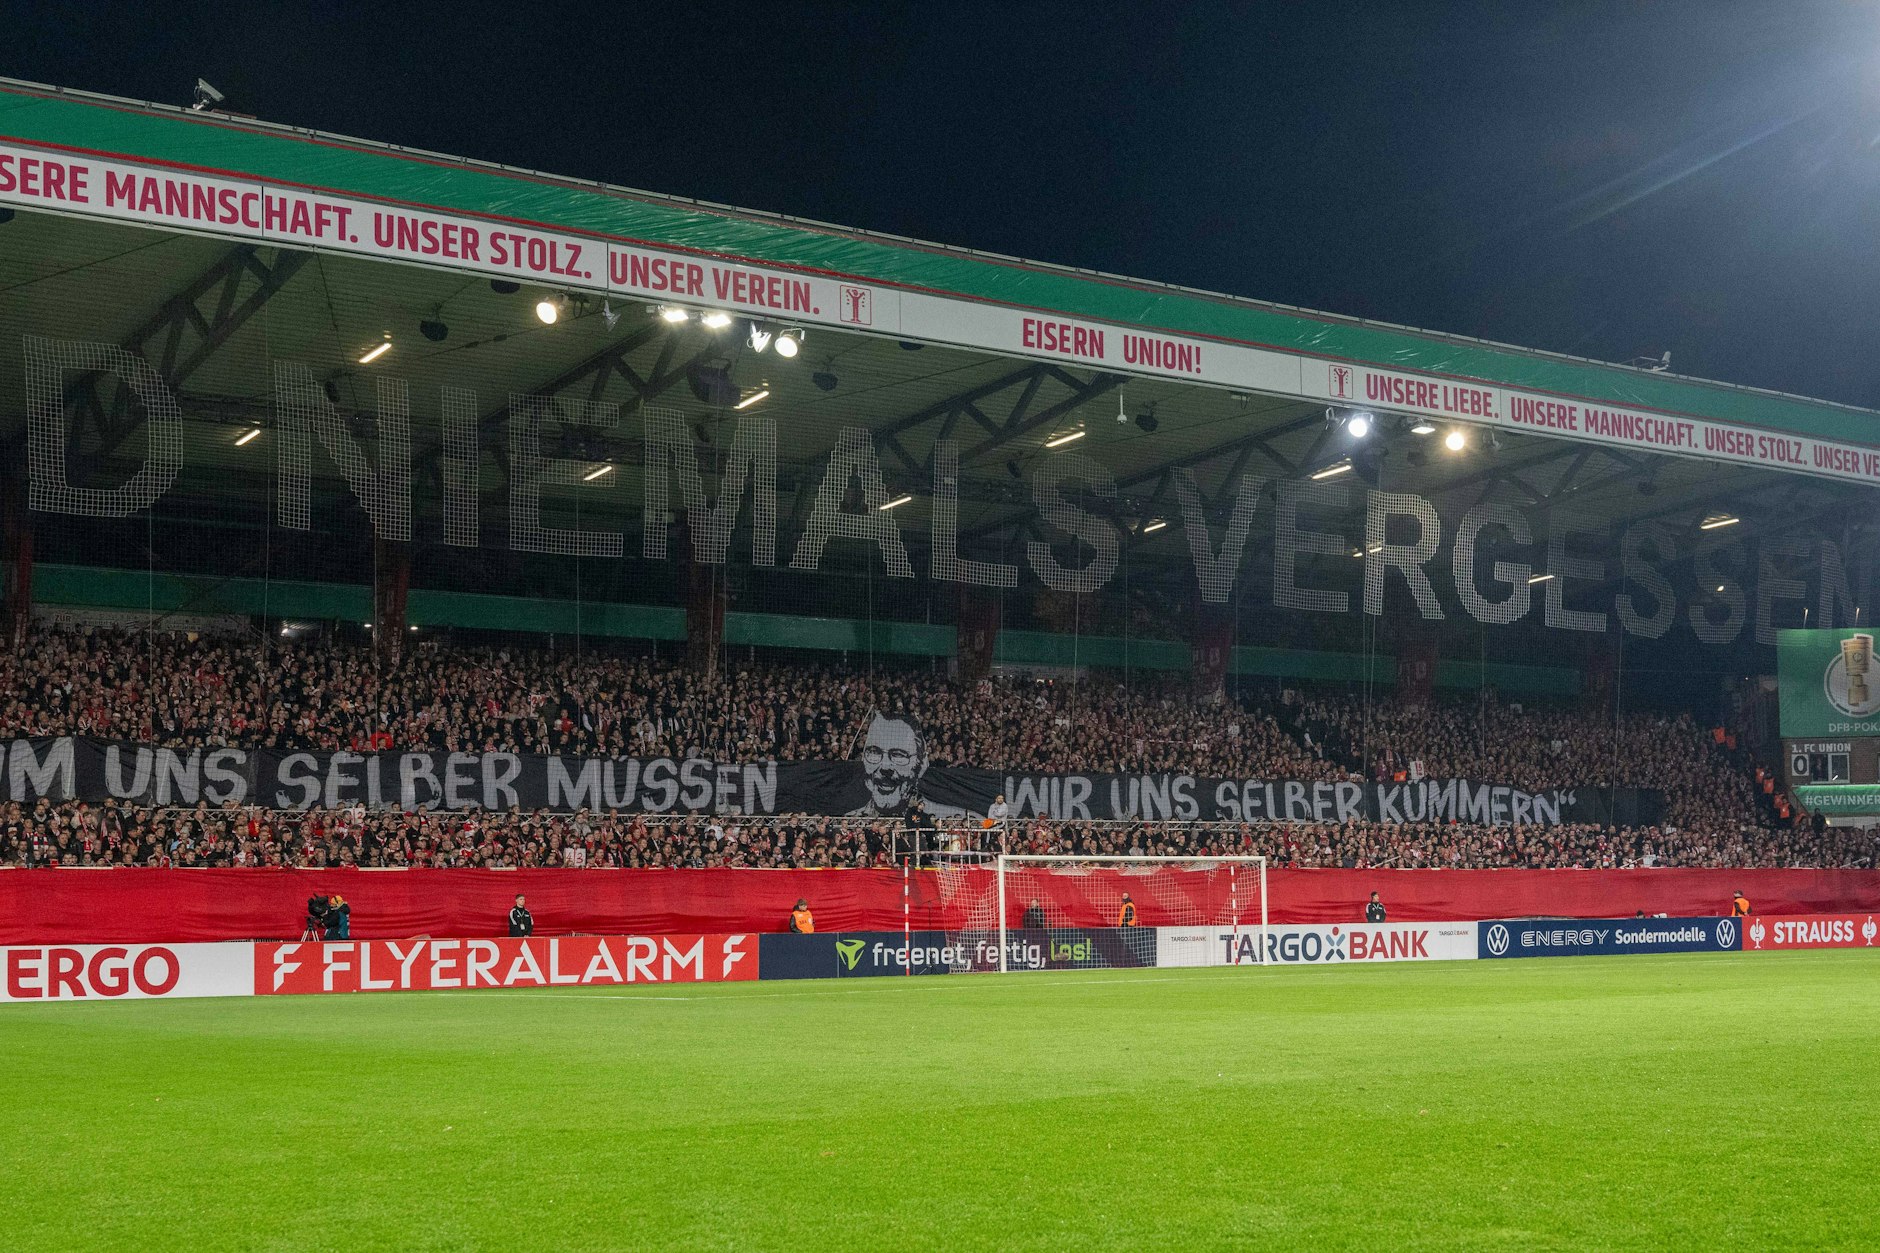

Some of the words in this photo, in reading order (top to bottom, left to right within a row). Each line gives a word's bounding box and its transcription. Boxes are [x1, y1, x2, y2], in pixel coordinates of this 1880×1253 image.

[0, 154, 89, 203] SERE
[105, 170, 358, 243] MANNSCHAFT.
[374, 212, 480, 262] UNSER
[489, 231, 592, 279] STOLZ.
[609, 251, 705, 300] UNSER
[712, 267, 820, 315] VEREIN.
[1022, 318, 1104, 359] EISERN
[1123, 334, 1201, 374] UNION!
[1366, 373, 1439, 409] UNSERE
[1442, 385, 1499, 419] LIEBE.
[1510, 396, 1578, 431] UNSERE
[1584, 408, 1698, 449] MANNSCHAFT.
[1704, 427, 1755, 458] UNSER
[1758, 435, 1808, 466] STOLZ.
[1813, 444, 1861, 474] UNSER
[1863, 453, 1880, 477] VE
[273, 359, 1119, 593] NIEMALS
[1169, 465, 1870, 646] VERGESSEN
[1792, 744, 1802, 752] 1.
[1804, 743, 1816, 753] FC
[1819, 743, 1851, 752] UNION
[1828, 722, 1880, 733] DFB-POK
[105, 744, 249, 806] UNS
[275, 750, 523, 812] SELBER
[1004, 775, 1094, 820] WIR
[1110, 774, 1200, 821] UNS
[1215, 779, 1363, 827] SELBER
[1520, 929, 1609, 948] ENERGY
[1615, 926, 1706, 946] Sondermodelle
[1773, 920, 1854, 944] STRAUSS
[7, 946, 181, 998] ERGO
[322, 935, 704, 991] FLYERALARM
